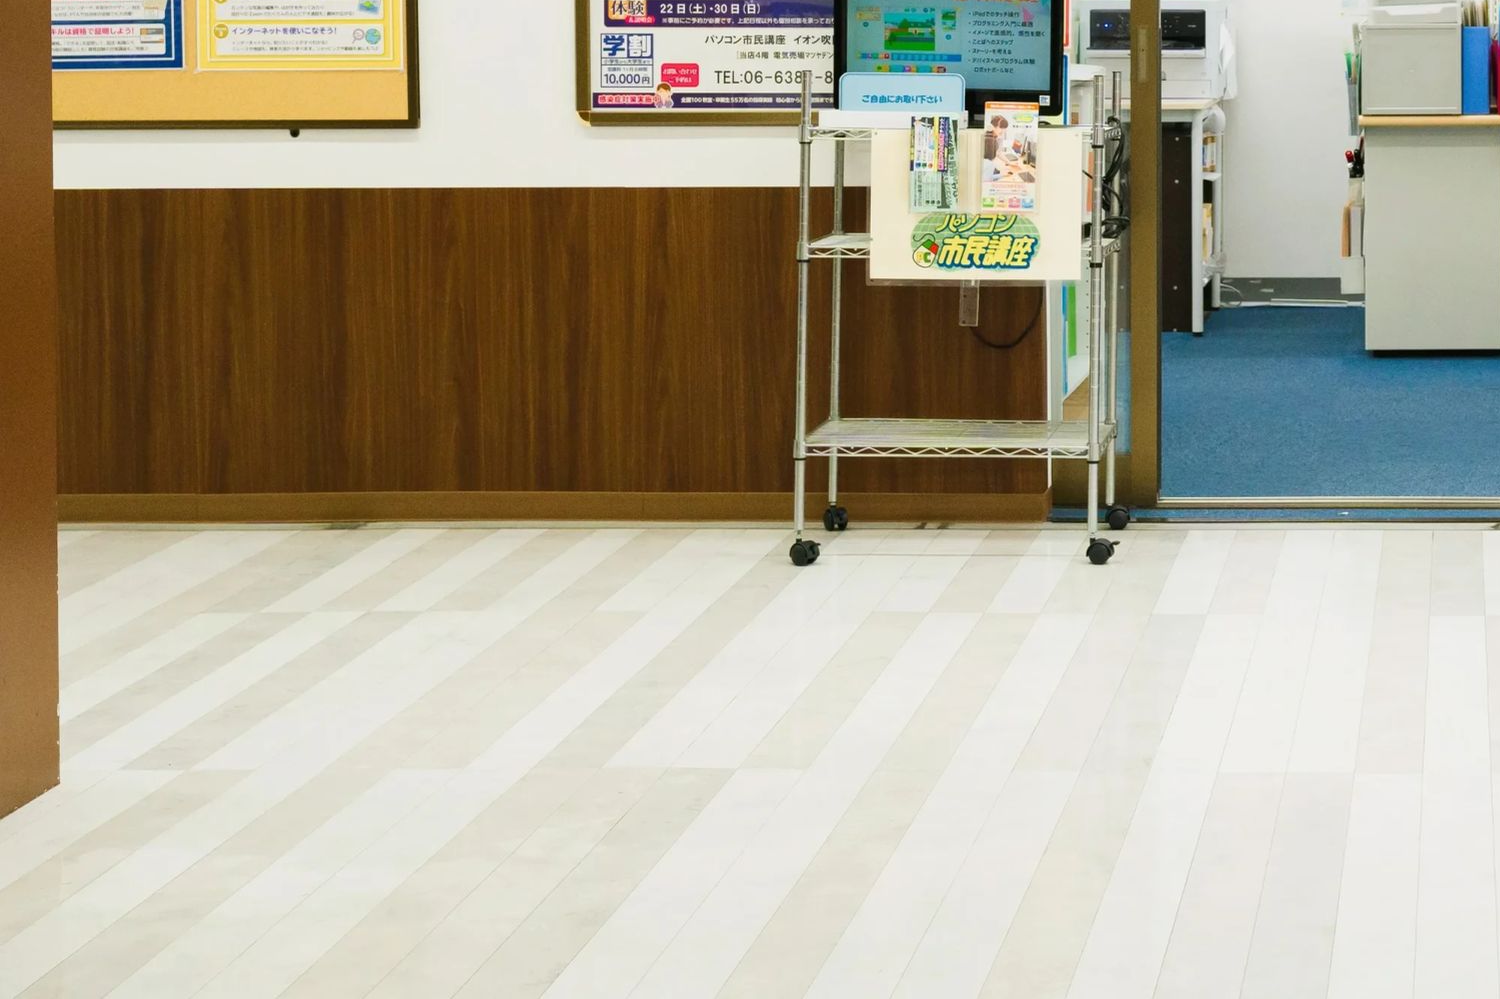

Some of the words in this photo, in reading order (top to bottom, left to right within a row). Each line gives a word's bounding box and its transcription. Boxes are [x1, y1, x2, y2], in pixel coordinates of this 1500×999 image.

[603, 34, 653, 57] 学割
[705, 34, 786, 46] パソコン市民講座
[793, 34, 834, 46] イオン吹
[714, 70, 834, 85] TEL:06-638-8
[862, 94, 942, 104] ご自由にお取り下さい
[936, 213, 1017, 233] パソコン
[938, 236, 1035, 267] 市民講座
